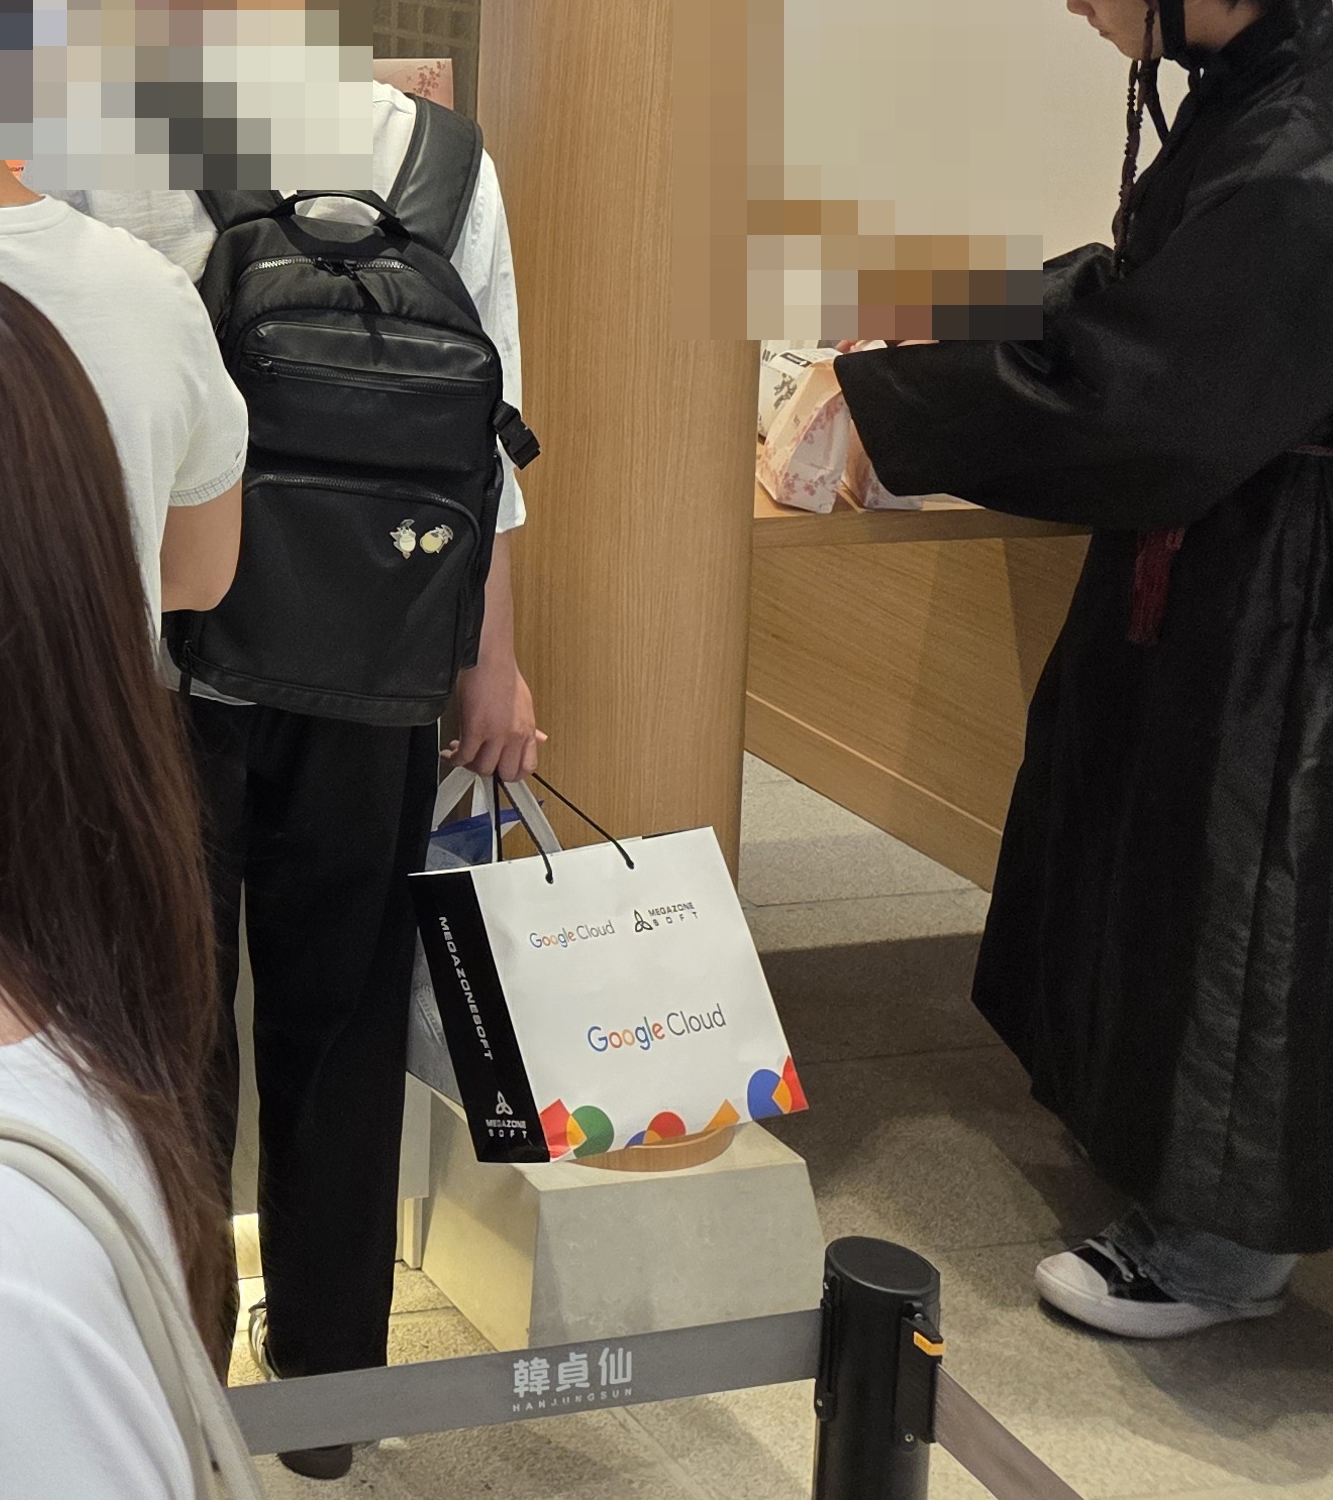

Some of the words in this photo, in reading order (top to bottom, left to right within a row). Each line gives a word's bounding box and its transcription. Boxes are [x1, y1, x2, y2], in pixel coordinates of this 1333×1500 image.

[647, 901, 695, 917] MEGAZONE
[652, 911, 699, 926] SOFT
[529, 927, 576, 948] Google
[576, 920, 615, 940] Cloud
[439, 916, 493, 1060] MEGAZONESOFT
[587, 1016, 665, 1052] Google
[666, 1002, 726, 1036] Cloud
[488, 1128, 527, 1139] SOFT
[513, 1347, 632, 1398] 韓貞仙
[512, 1387, 633, 1412] HANJUNGSUN
